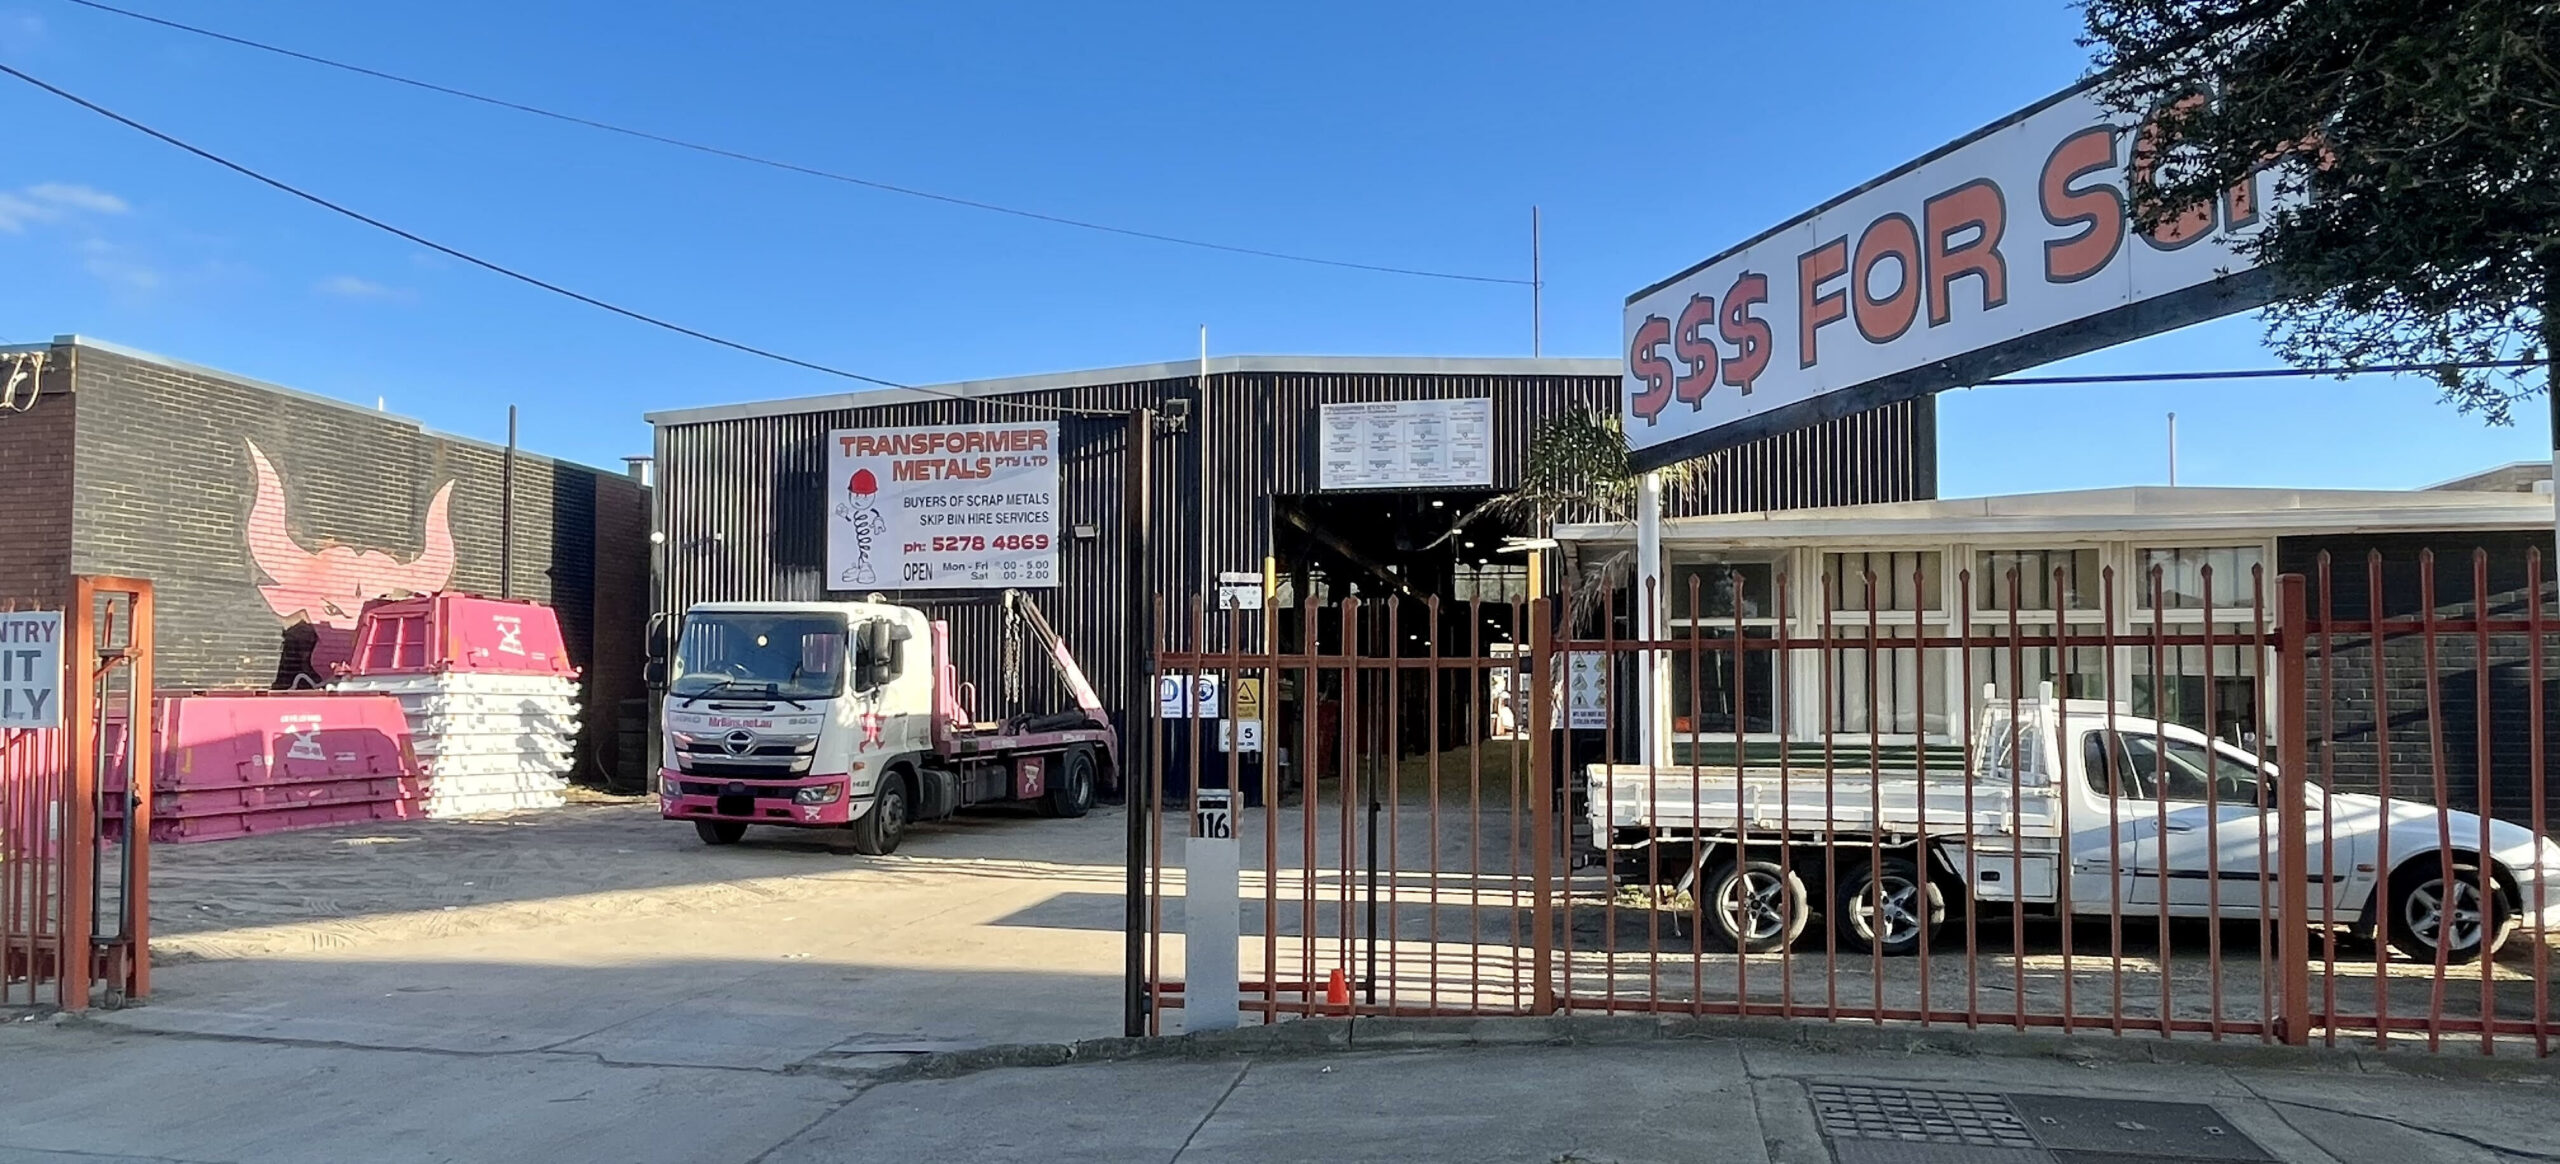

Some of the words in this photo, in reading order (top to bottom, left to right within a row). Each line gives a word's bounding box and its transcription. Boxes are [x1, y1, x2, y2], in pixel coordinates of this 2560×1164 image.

[1798, 177, 2007, 371] FOR
[840, 429, 1048, 457] TRANSFORMER
[892, 457, 992, 481] METALS
[995, 457, 1021, 468] PTY
[1023, 456, 1048, 467] LTD
[904, 496, 947, 508] BUYERS
[950, 495, 964, 507] OF
[967, 495, 1003, 507] SCRAP
[1006, 493, 1049, 505] METALS
[920, 514, 944, 526] SKIP
[947, 513, 965, 525] BIN
[968, 512, 993, 524] HIRE
[995, 511, 1049, 524] SERVICES
[904, 542, 926, 555] ph:
[932, 536, 985, 551] 5278
[992, 534, 1049, 550] 4869
[904, 563, 932, 582] OPEN
[943, 562, 965, 571] Mon
[975, 561, 988, 570] Fri
[1026, 560, 1049, 569] 5.00
[971, 571, 988, 580] Sat
[1026, 571, 1049, 579] 2.00
[1197, 812, 1230, 838] 116
